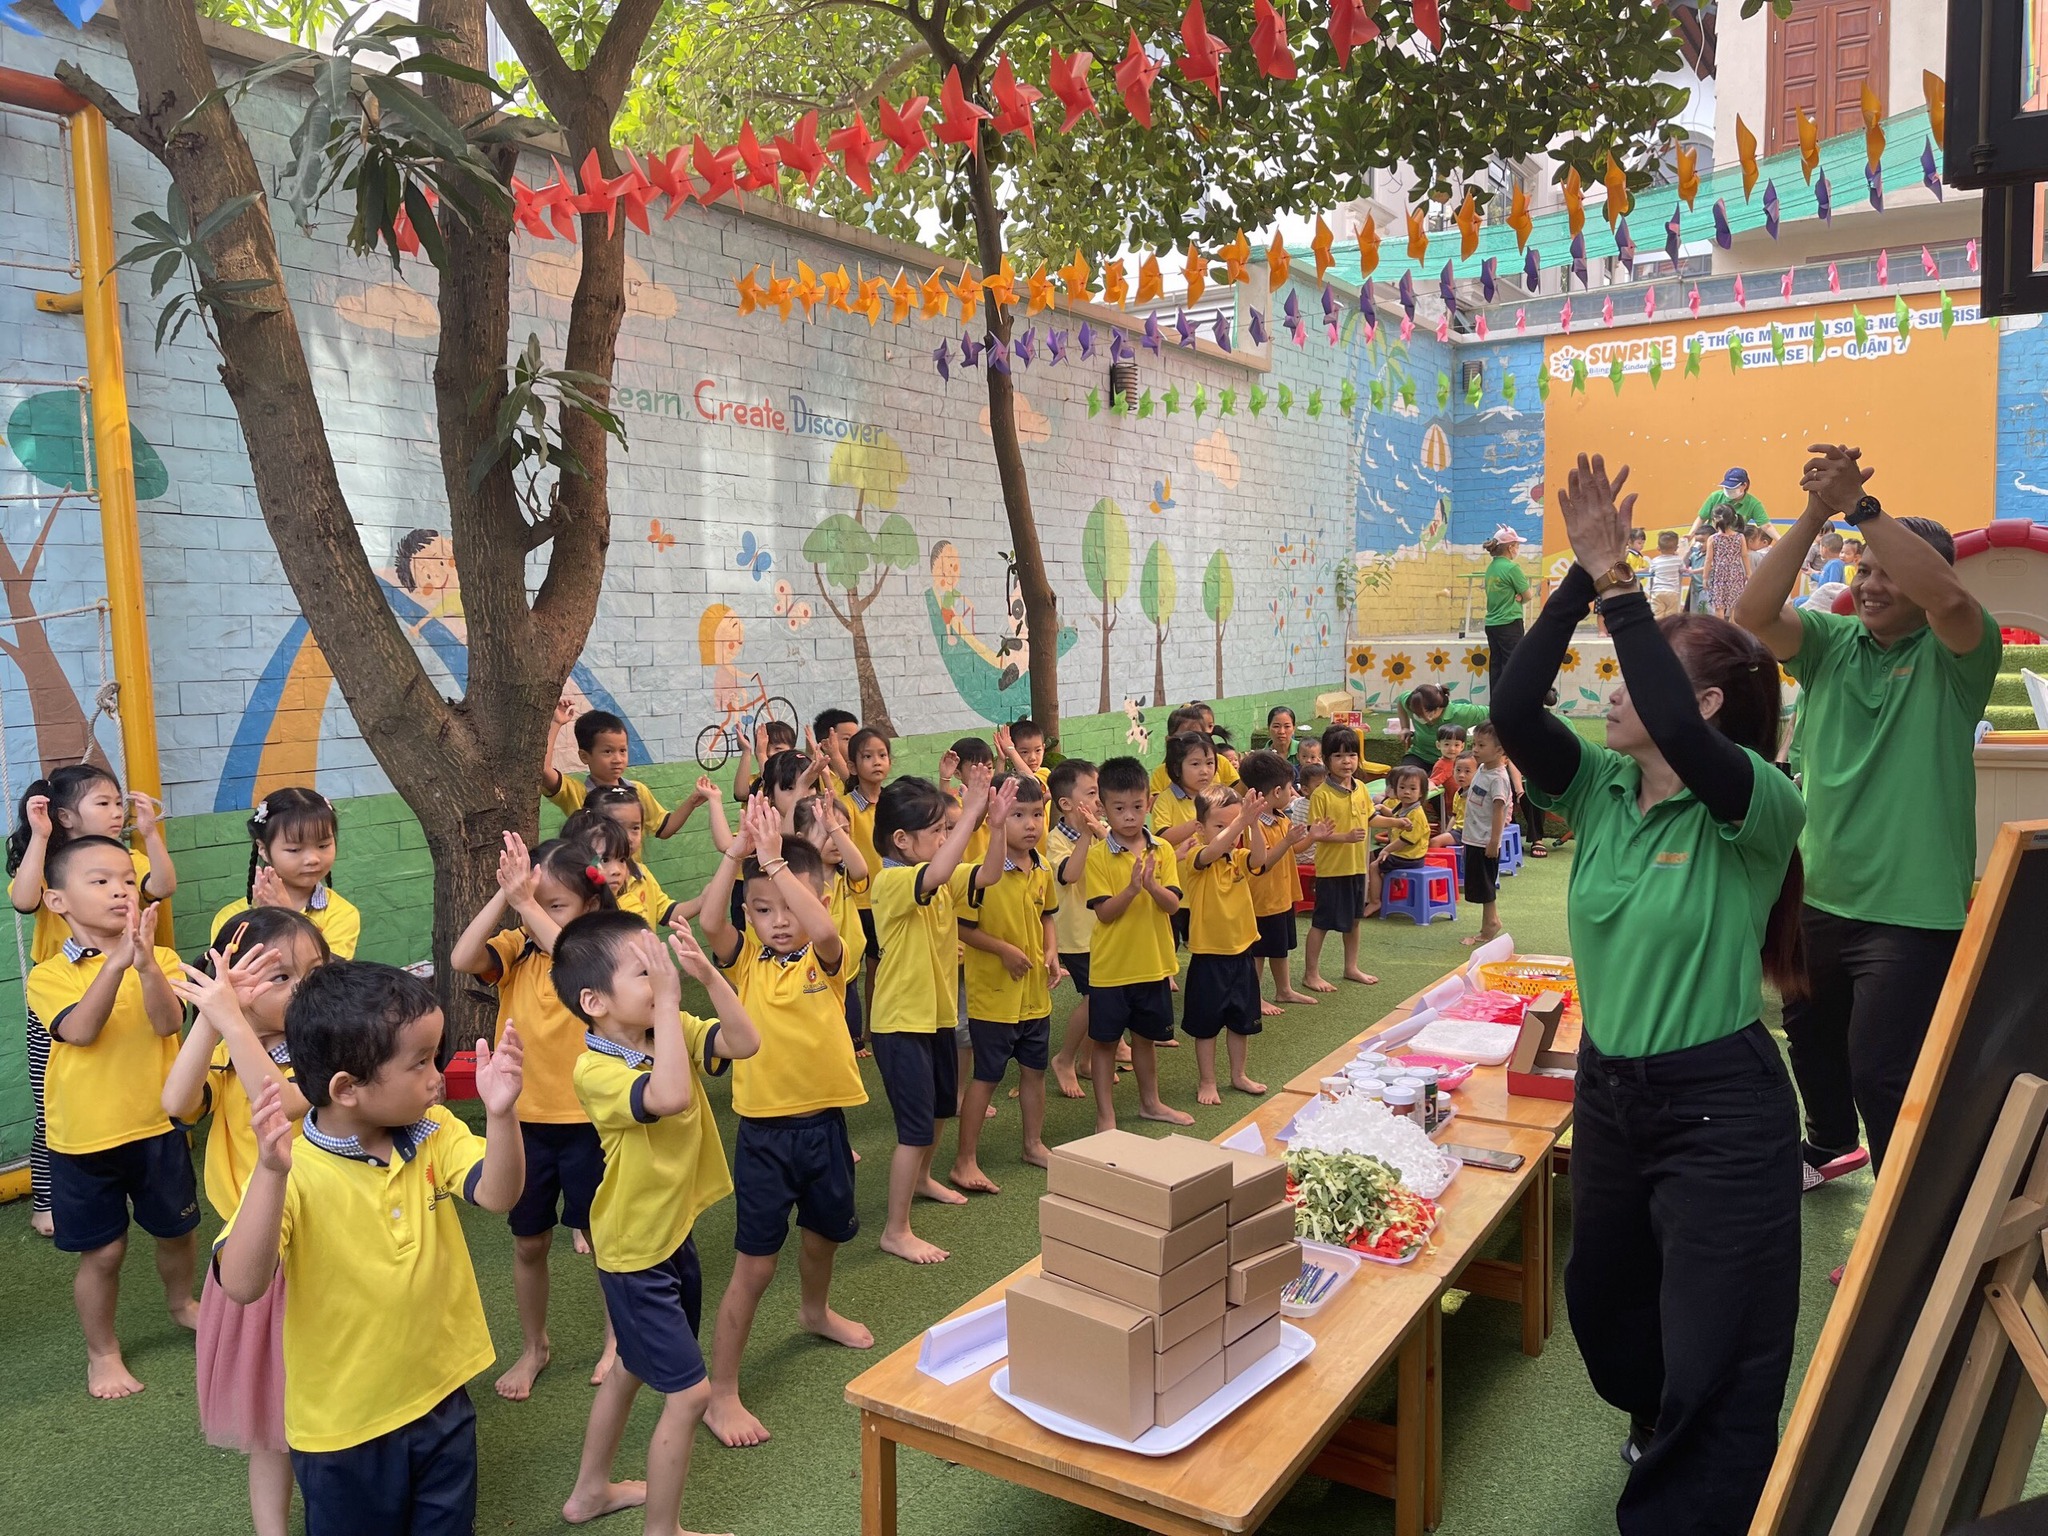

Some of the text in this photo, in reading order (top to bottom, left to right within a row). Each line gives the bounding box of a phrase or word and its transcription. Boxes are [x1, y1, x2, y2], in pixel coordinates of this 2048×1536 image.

[1758, 326, 1794, 341] MM
[1834, 319, 1874, 334] SOG
[1743, 348, 1804, 365] SUNSE
[609, 380, 884, 446] earn, Create, Discover
